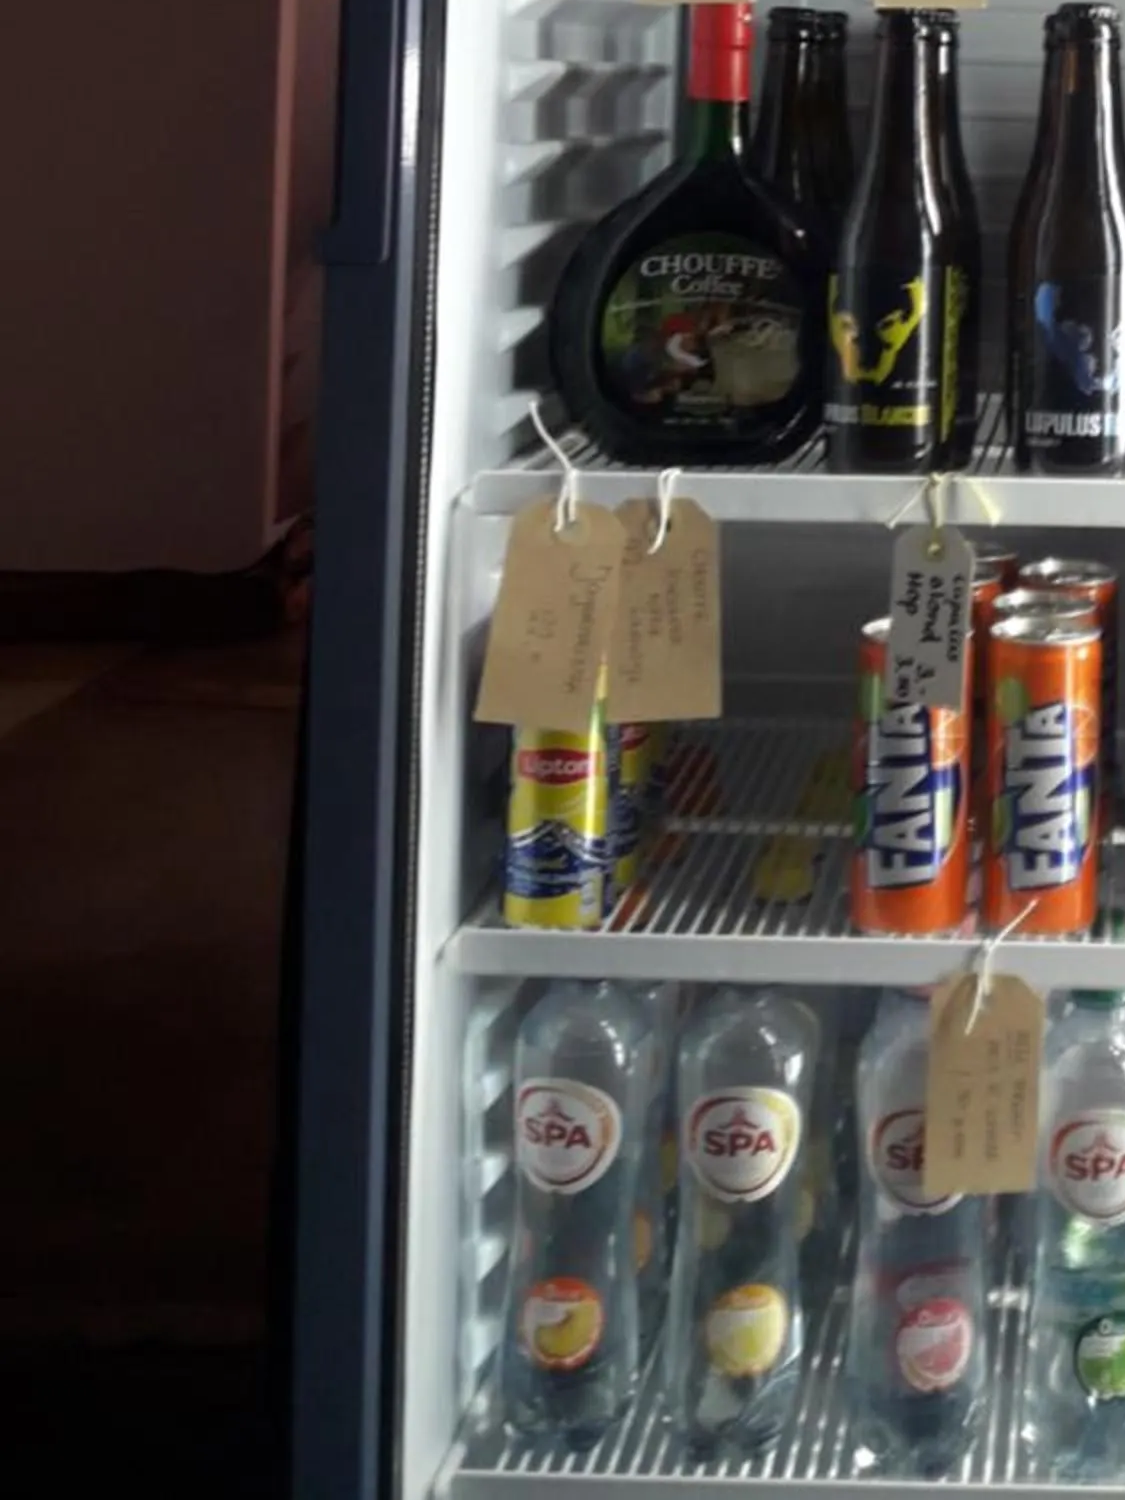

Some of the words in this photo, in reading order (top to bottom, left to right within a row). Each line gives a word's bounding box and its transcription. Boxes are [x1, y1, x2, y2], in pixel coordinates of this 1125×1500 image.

[640, 253, 781, 279] CHOUFFE
[866, 702, 938, 888] FANTA
[1005, 702, 1078, 890] FANTA
[524, 1119, 593, 1150] SPA
[703, 1130, 775, 1158] SPA
